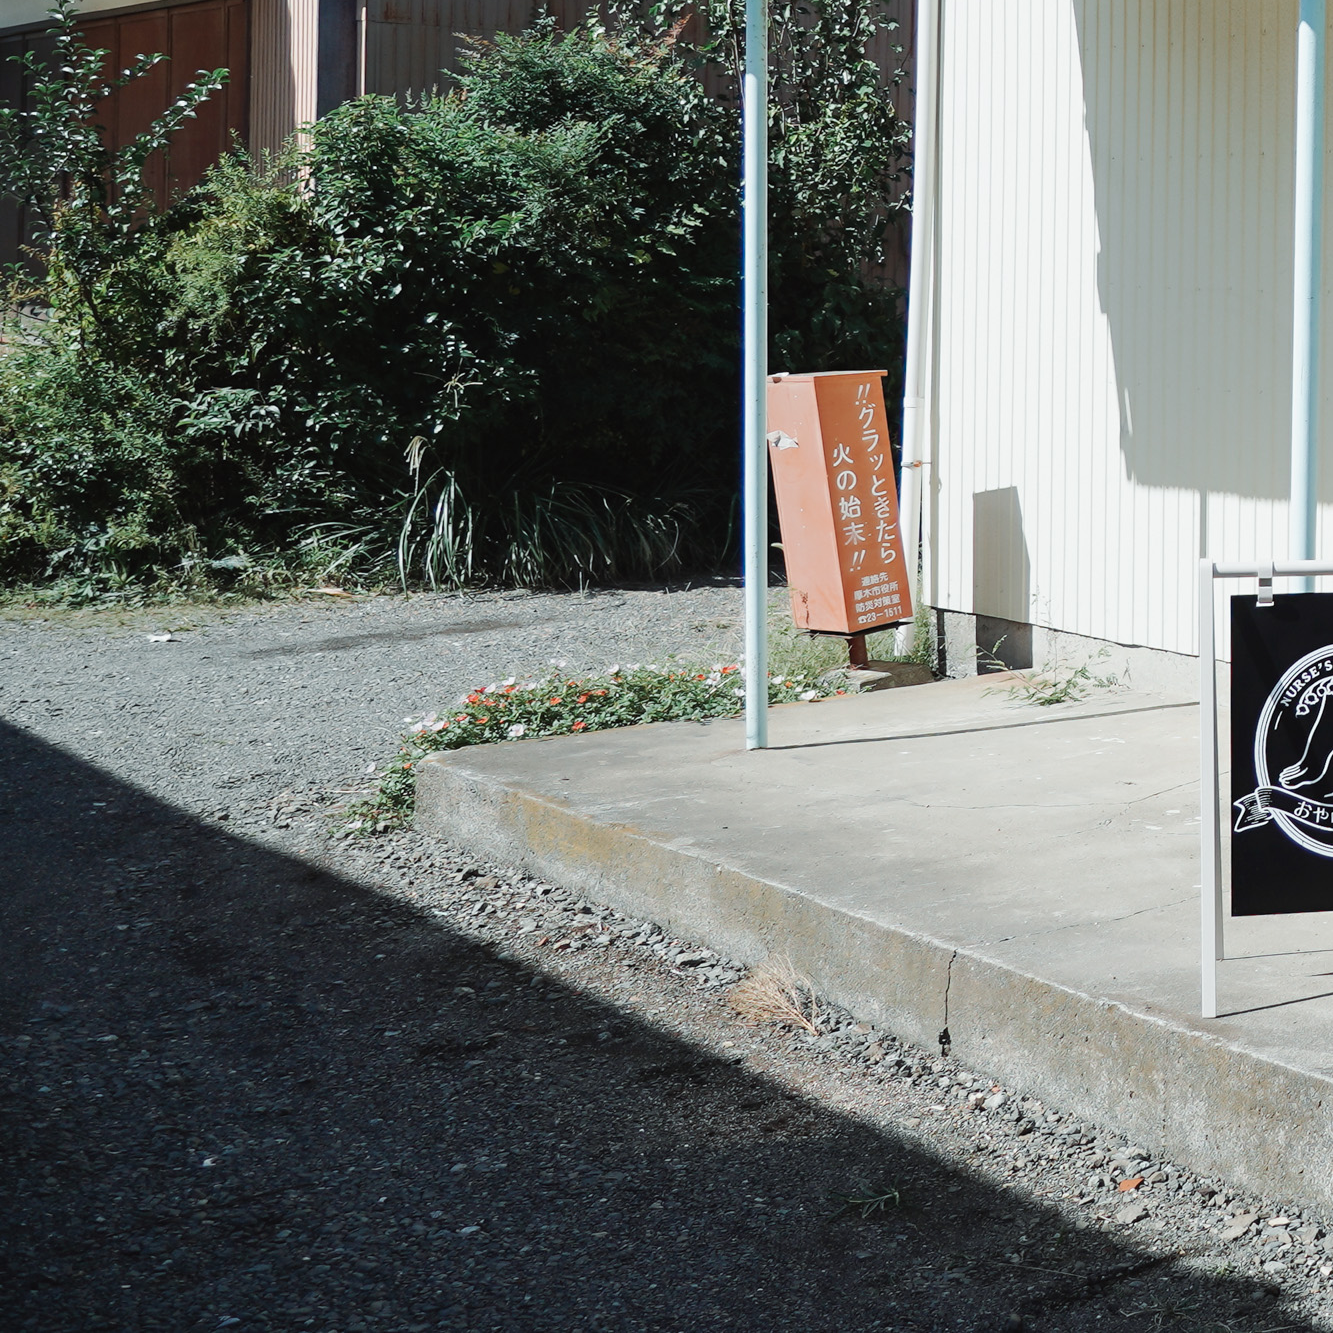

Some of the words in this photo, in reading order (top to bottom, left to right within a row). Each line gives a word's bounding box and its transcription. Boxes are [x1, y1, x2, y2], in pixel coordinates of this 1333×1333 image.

[861, 572, 889, 586] 連絡先
[856, 594, 901, 613] 防災対策室
